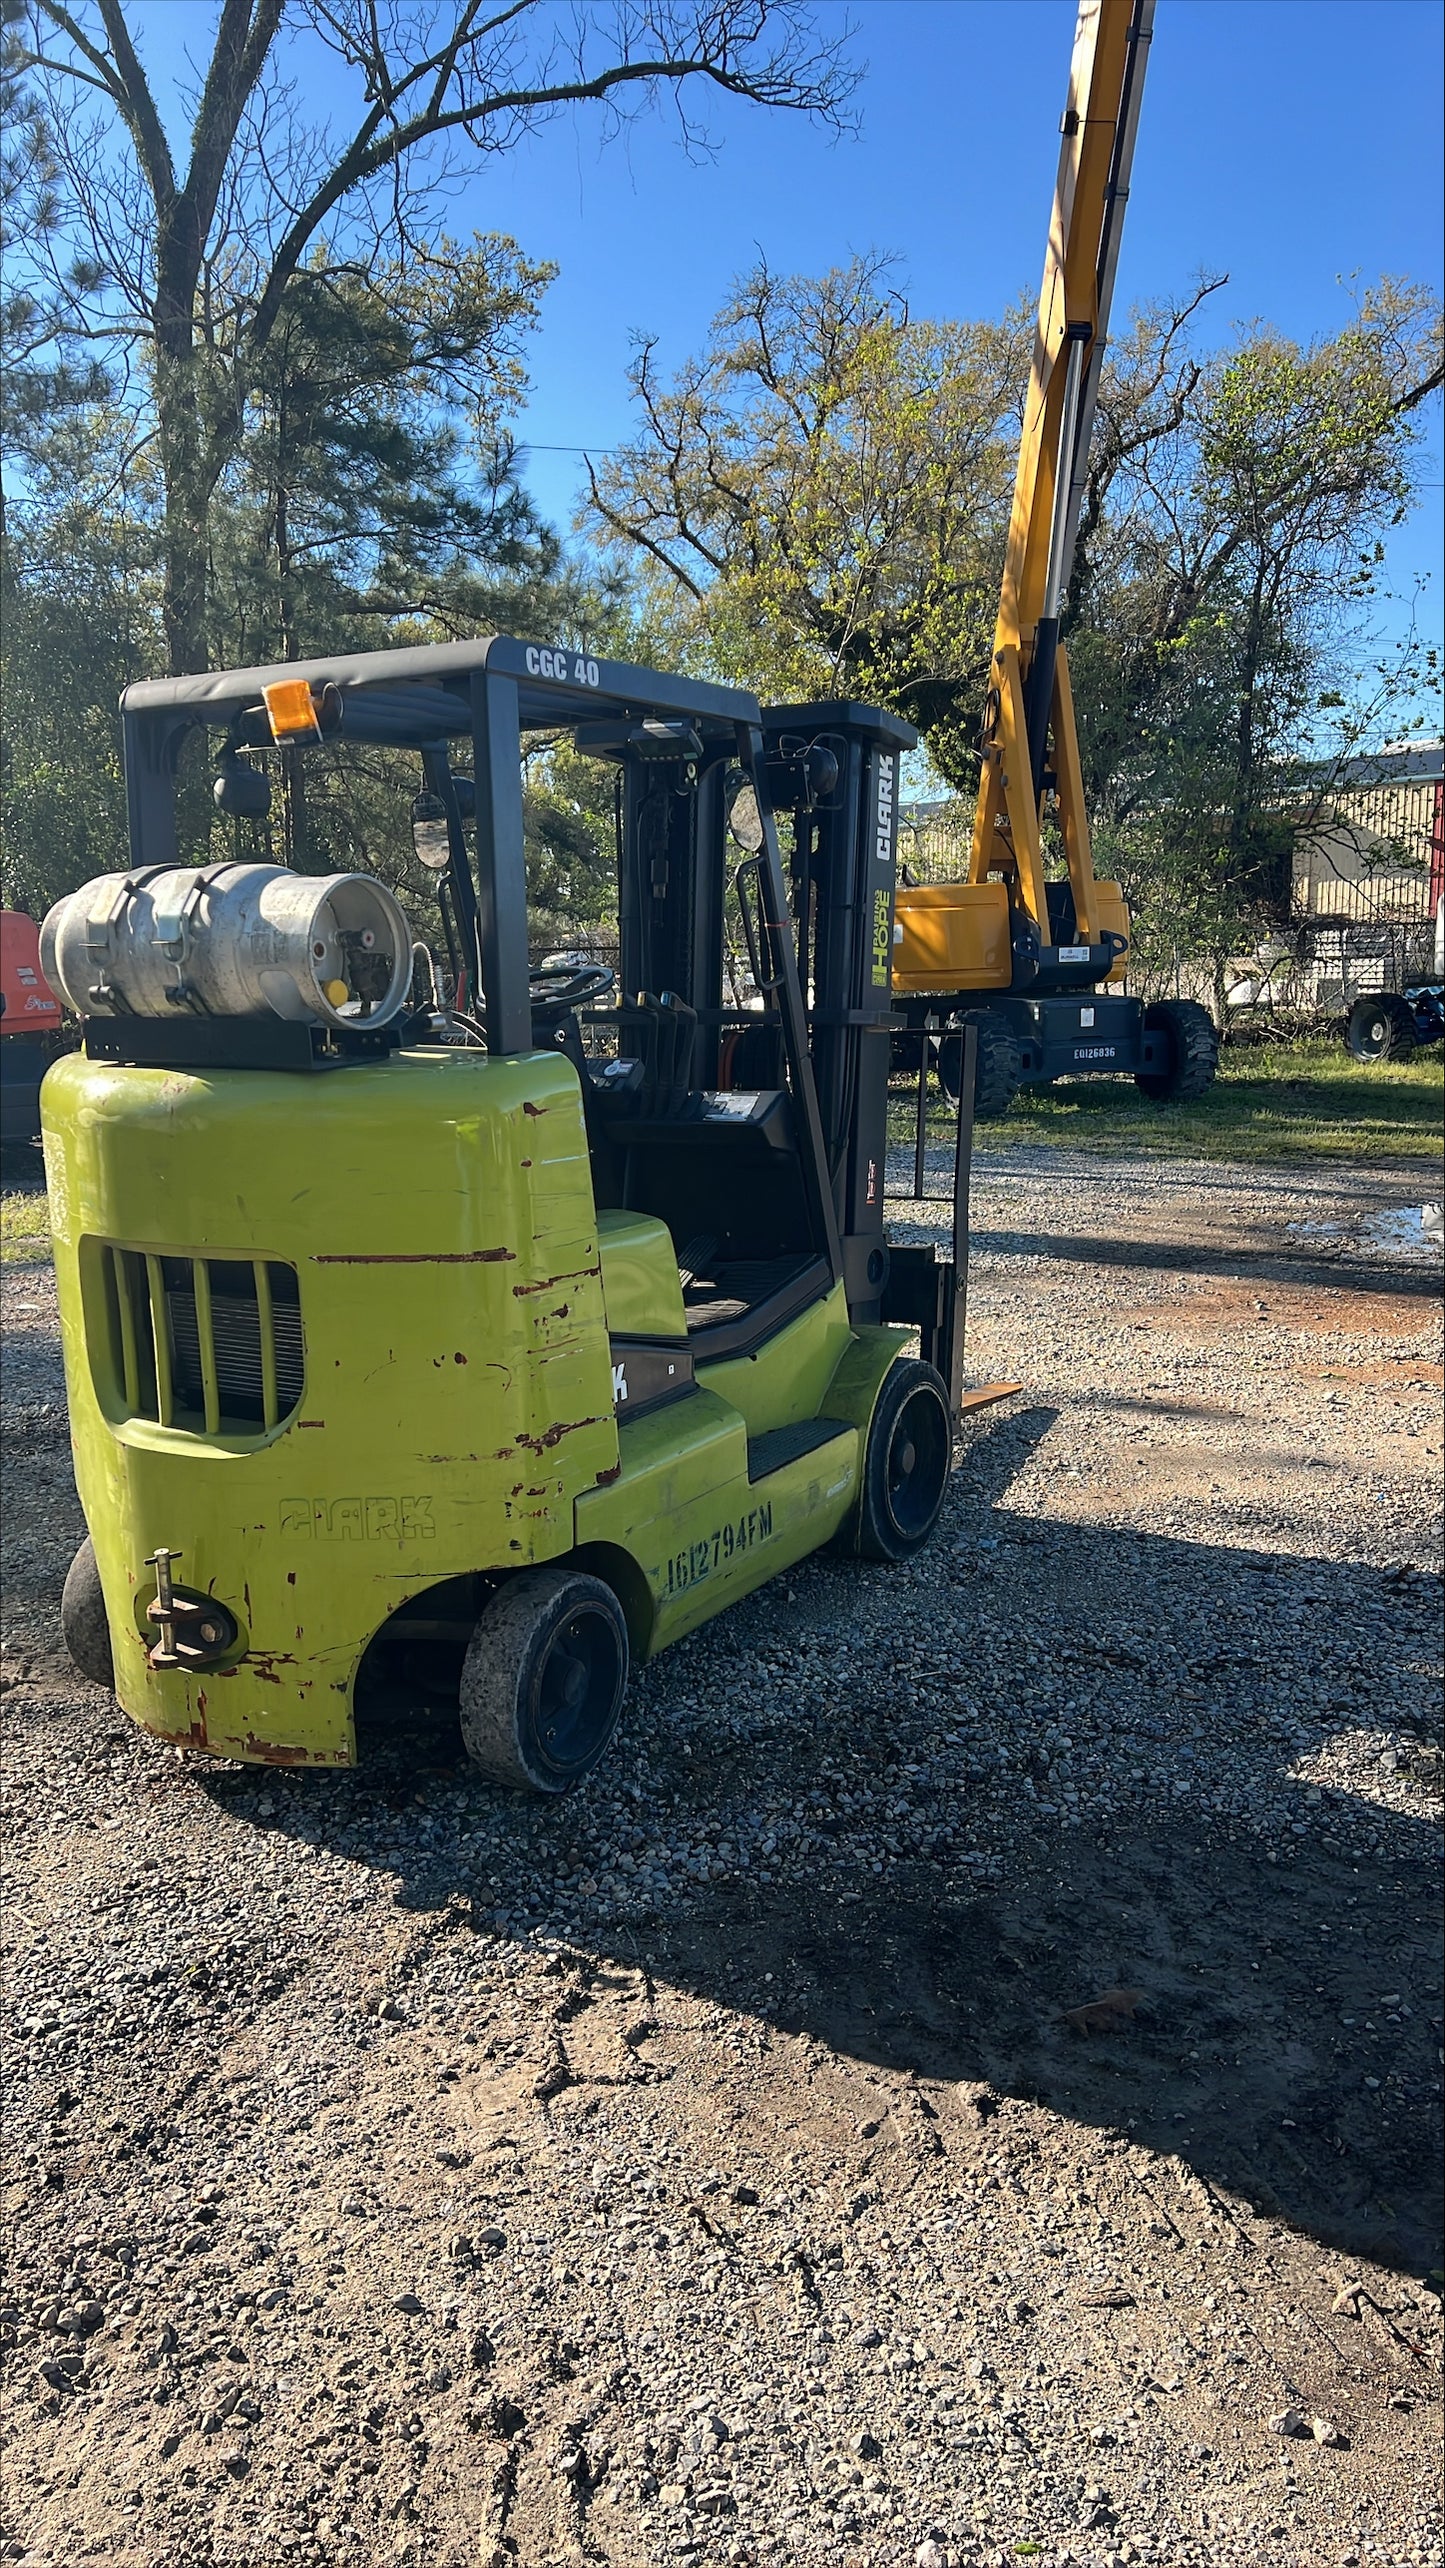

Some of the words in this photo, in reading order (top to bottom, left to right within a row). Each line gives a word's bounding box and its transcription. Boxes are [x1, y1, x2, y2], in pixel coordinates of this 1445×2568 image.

[525, 646, 567, 680] CGC
[574, 658, 599, 687] 40
[876, 754, 893, 861] CLARK
[871, 889, 890, 974] HOPE
[279, 1495, 436, 1541] CLARK
[667, 1500, 772, 1594] 1612794FM
